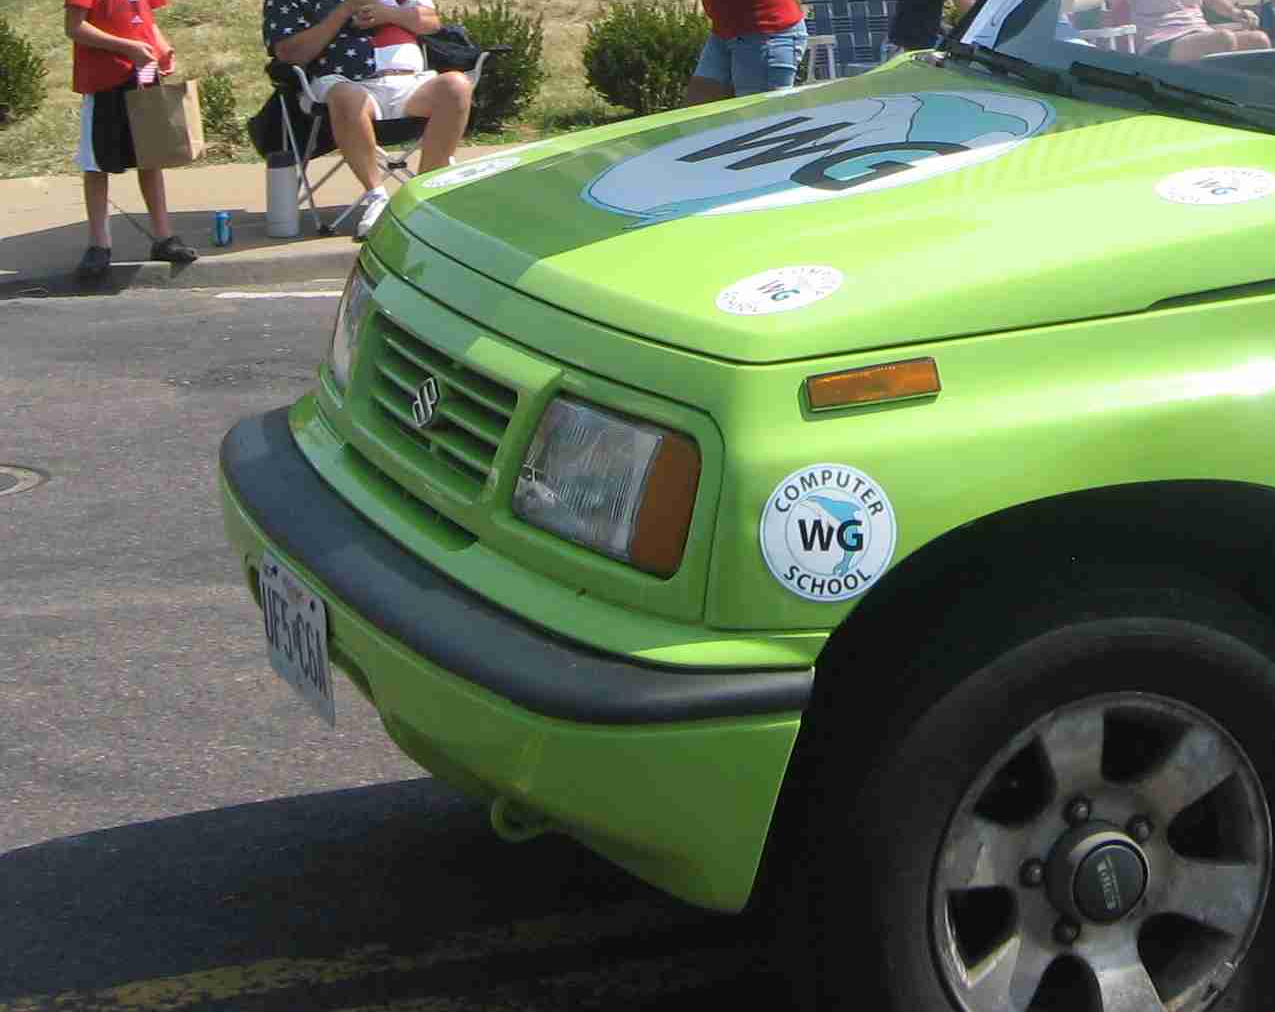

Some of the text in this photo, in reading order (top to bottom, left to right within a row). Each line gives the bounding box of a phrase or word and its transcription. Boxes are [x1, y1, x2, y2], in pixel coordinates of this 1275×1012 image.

[675, 116, 972, 191] WG
[755, 279, 800, 301] WG
[775, 469, 884, 516] COMPUTER
[798, 519, 864, 552] WG
[784, 565, 871, 595] SCHOOL
